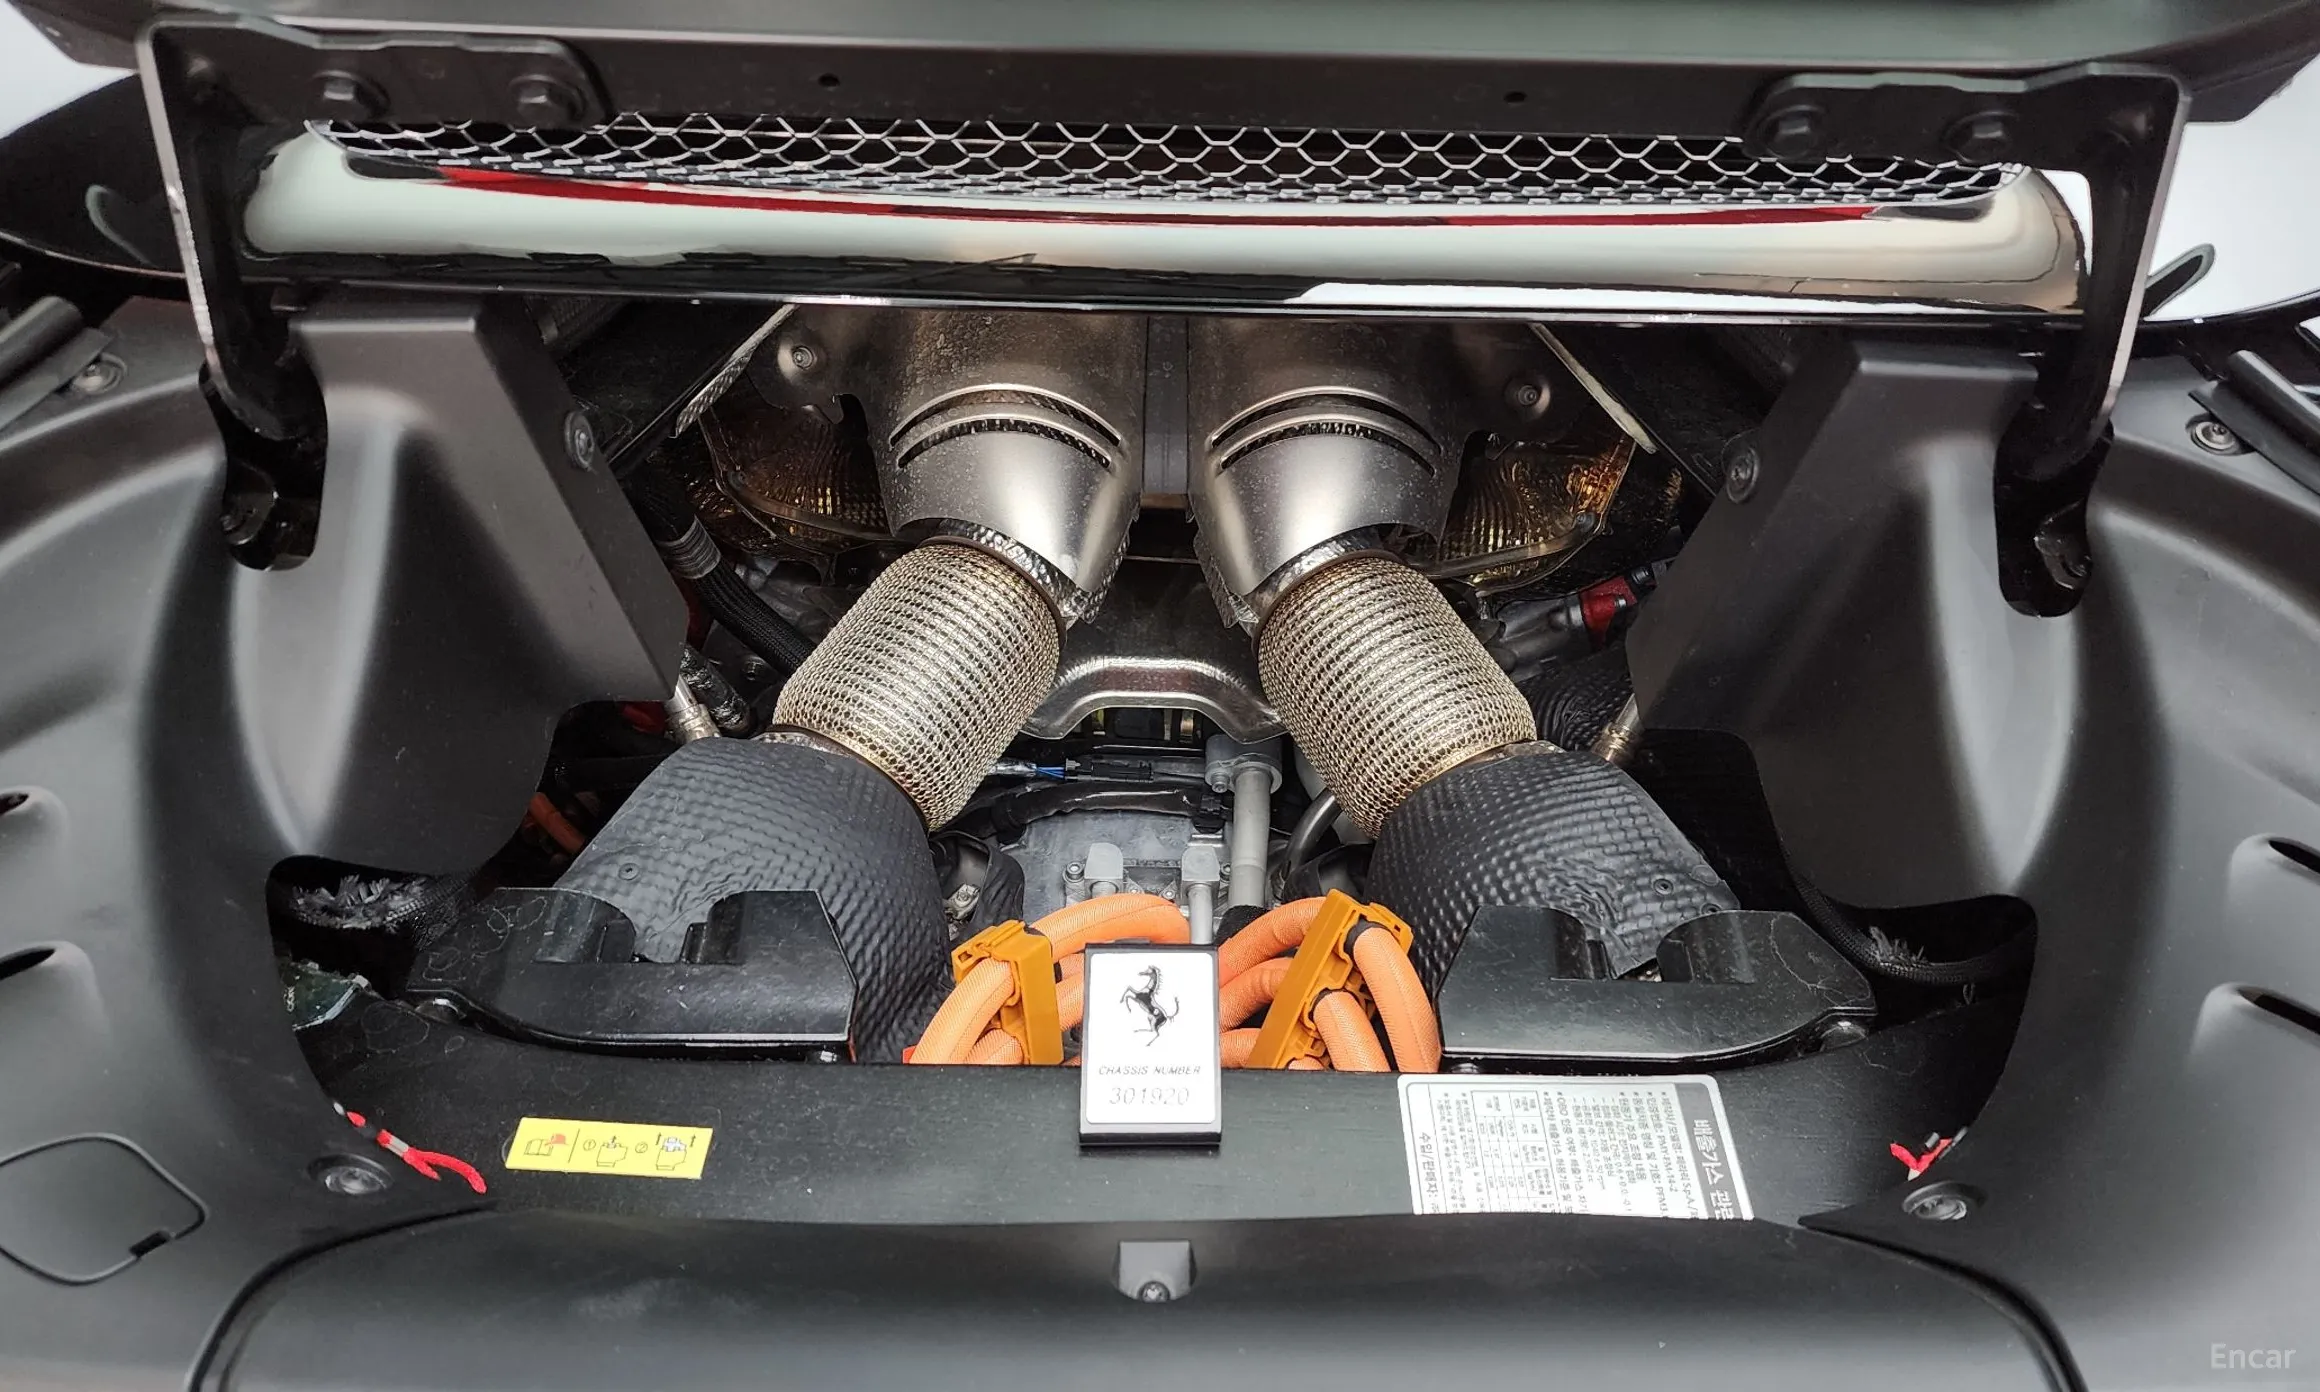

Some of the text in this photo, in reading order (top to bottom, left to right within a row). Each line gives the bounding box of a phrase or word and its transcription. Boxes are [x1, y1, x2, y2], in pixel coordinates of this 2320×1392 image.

[1098, 1065, 1201, 1076] CHASSIS NUMBER
[1109, 1087, 1191, 1106] 301920
[1555, 1097, 1569, 1116] OBD
[1646, 1097, 1664, 1132] 인증번호:
[1560, 1118, 1573, 1134] 인증
[1624, 1123, 1637, 1141] 주요
[1547, 1123, 1562, 1155] 배출가스
[1628, 1143, 1642, 1160] 조정
[1644, 1152, 1656, 1160] 및
[1690, 1119, 1727, 1184] 배출가스
[1417, 1131, 1438, 1197] 수입/판매자:
[1633, 1163, 1647, 1180] 내용
[1648, 1163, 1662, 1183] 기호:
[1674, 1155, 1690, 1180] 페라리
[1554, 1157, 1569, 1191] 허용기준
[1568, 1158, 1584, 1191] 배출가스
